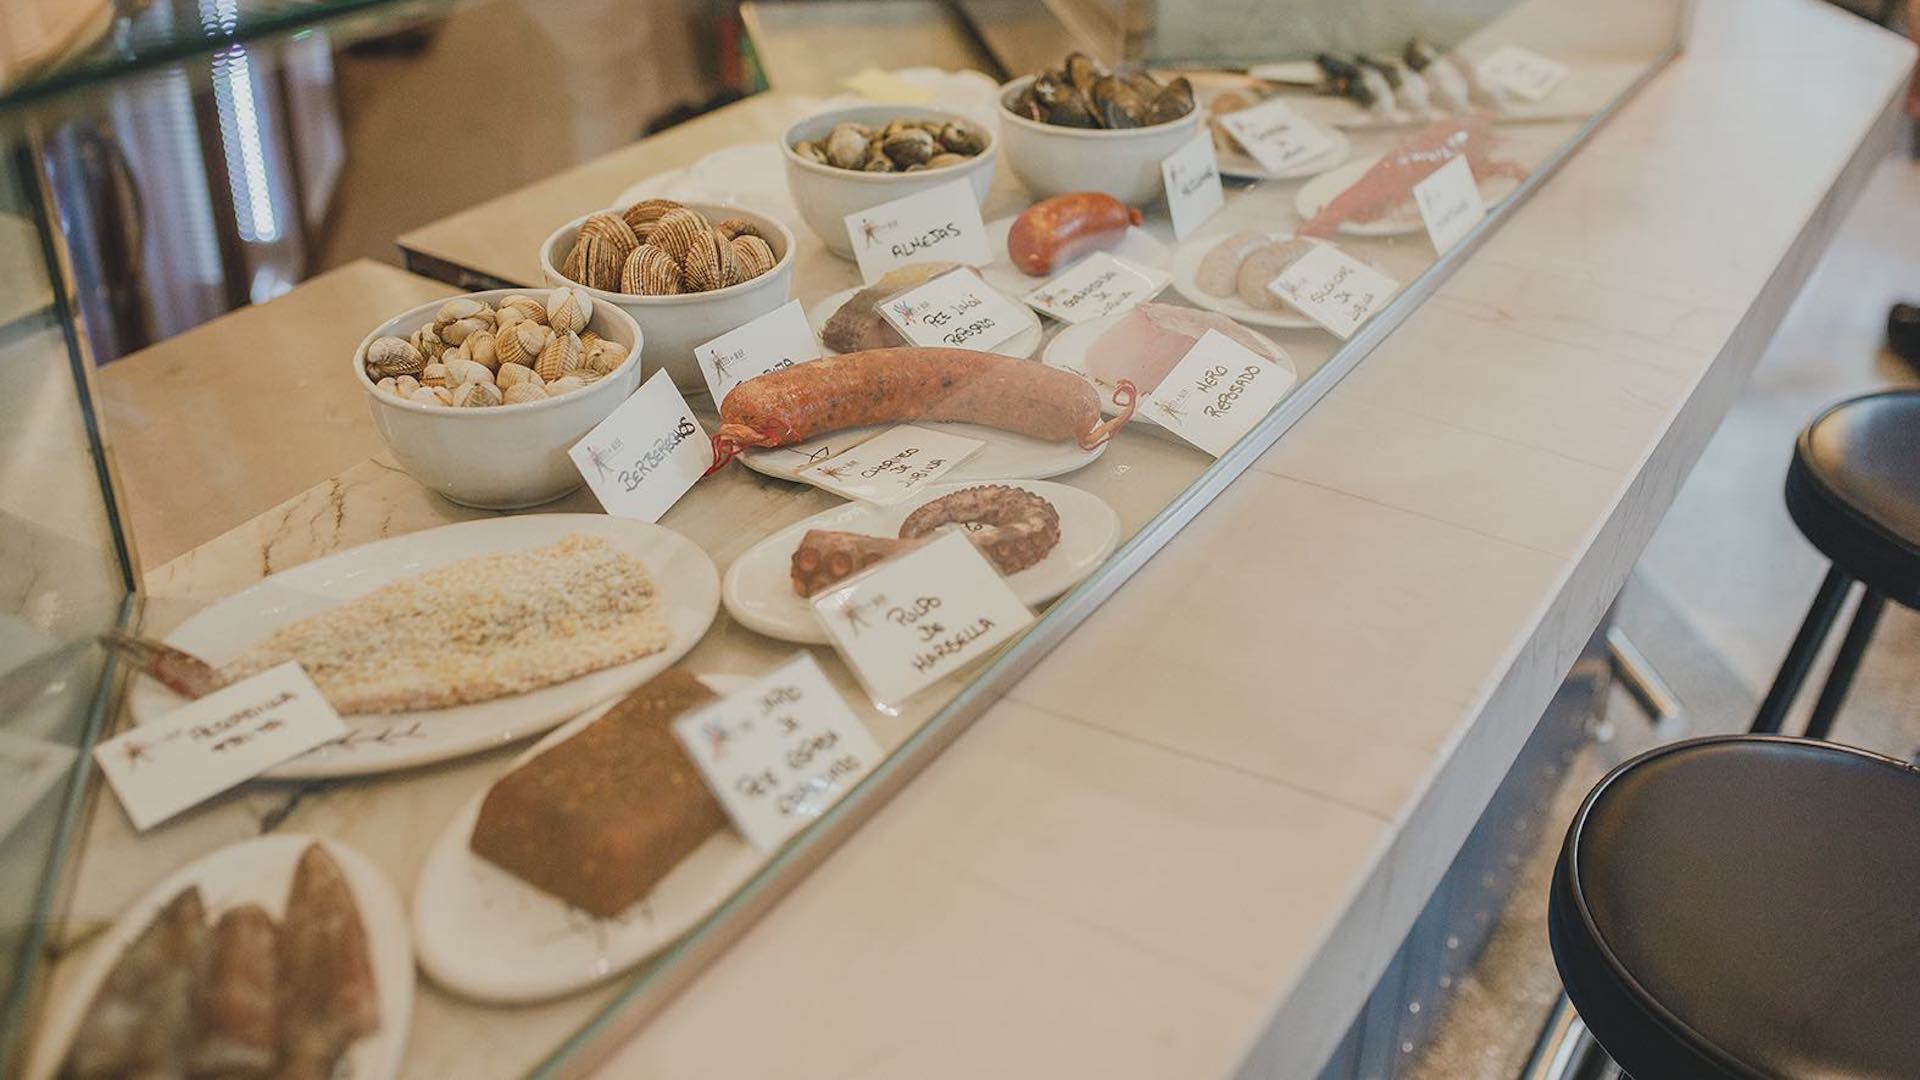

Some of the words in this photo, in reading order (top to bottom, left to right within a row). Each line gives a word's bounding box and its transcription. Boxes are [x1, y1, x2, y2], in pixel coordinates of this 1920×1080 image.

[891, 222, 961, 258] ALMEJAS
[922, 311, 952, 328] PEZ
[1195, 364, 1229, 394] MERO
[1203, 364, 1262, 419] REPOSADO
[910, 616, 996, 674] MARBELLA
